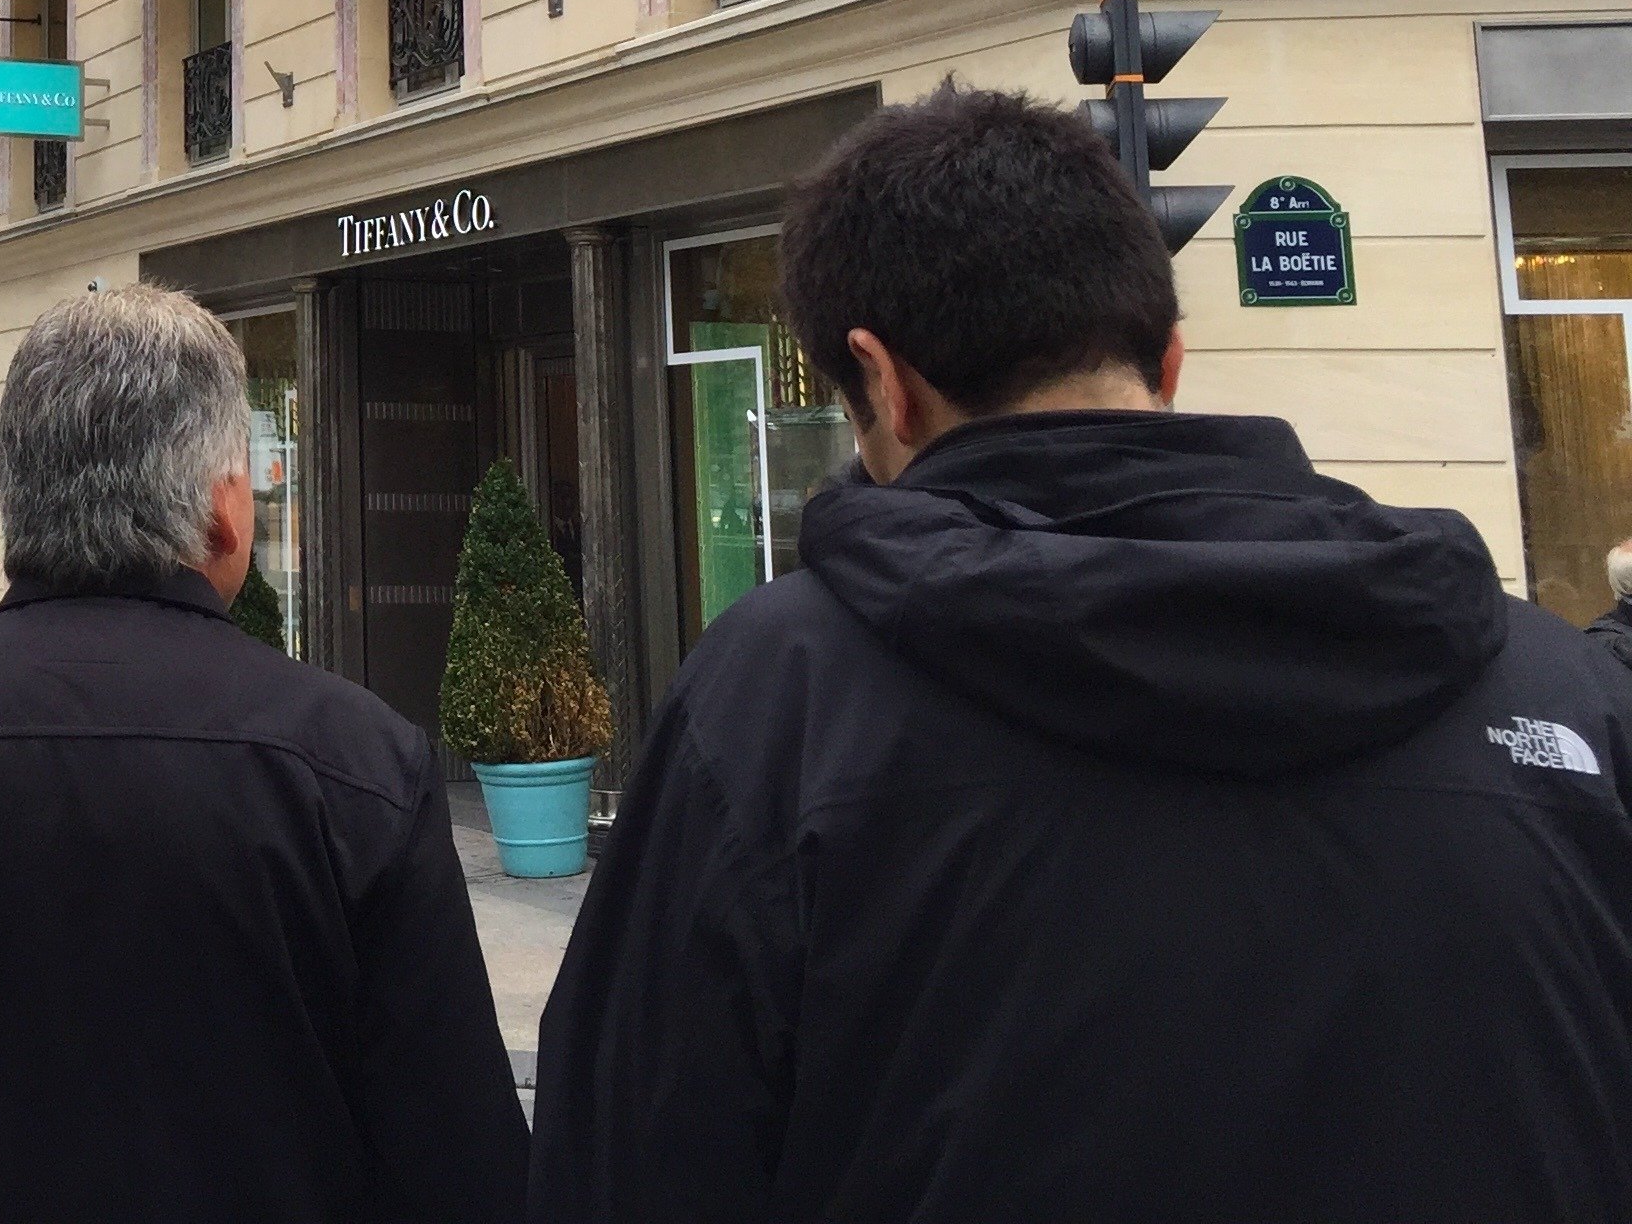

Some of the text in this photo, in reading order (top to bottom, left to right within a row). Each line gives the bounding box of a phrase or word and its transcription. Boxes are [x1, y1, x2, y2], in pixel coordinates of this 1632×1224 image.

[1275, 231, 1309, 247] RUE
[1252, 252, 1337, 272] LA BOËTIE
[1511, 716, 1555, 737] THE
[1486, 725, 1561, 755] NORTH
[1510, 746, 1565, 769] FACE
